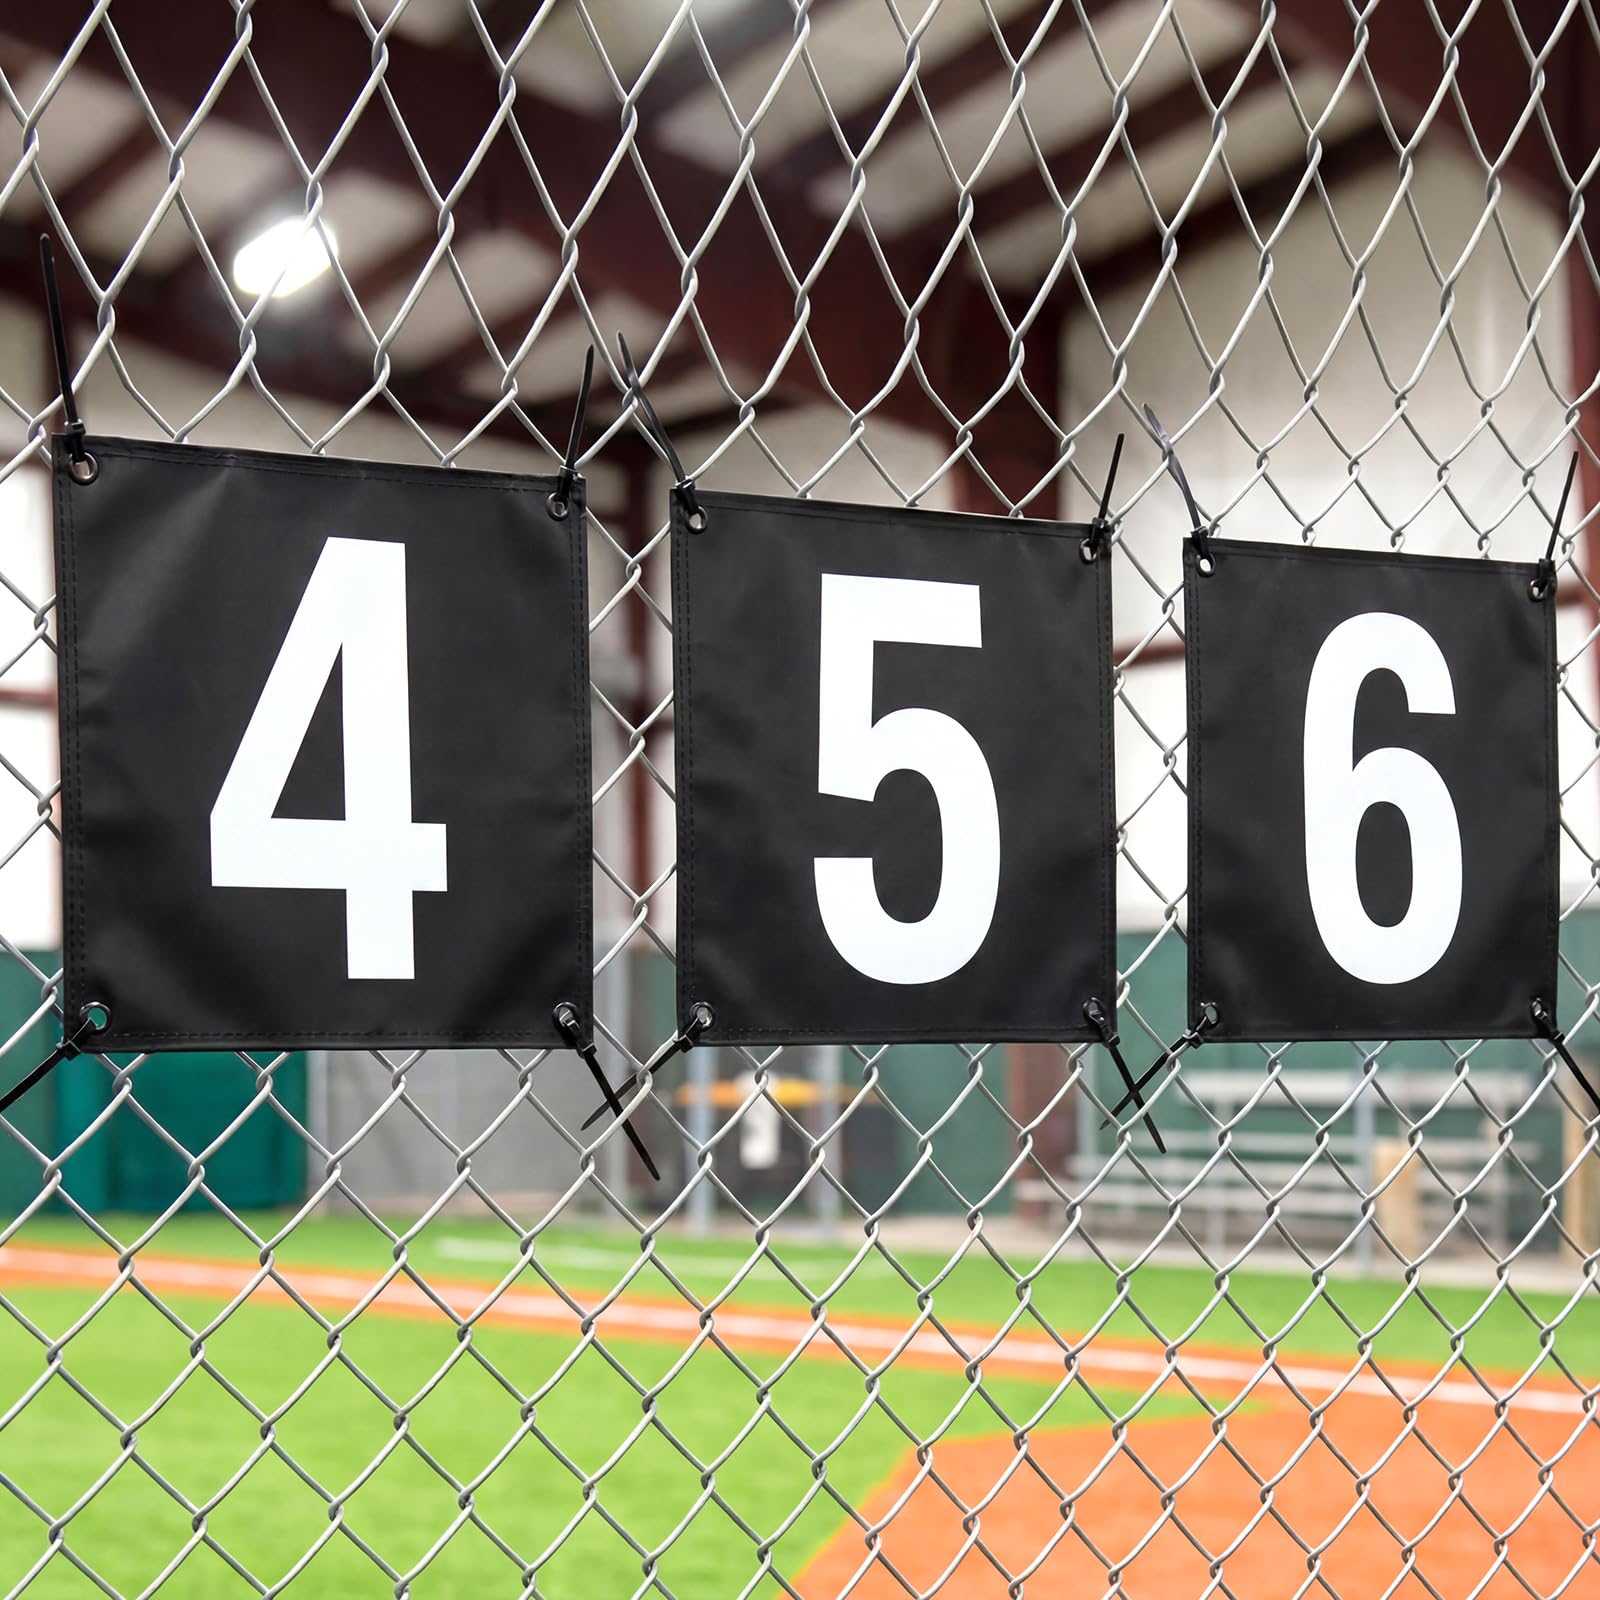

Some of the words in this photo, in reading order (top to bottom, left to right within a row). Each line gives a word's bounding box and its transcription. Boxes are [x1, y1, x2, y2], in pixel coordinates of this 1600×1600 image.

[210, 537, 448, 980] 4
[814, 573, 1001, 985] 5
[1304, 612, 1463, 985] 6
